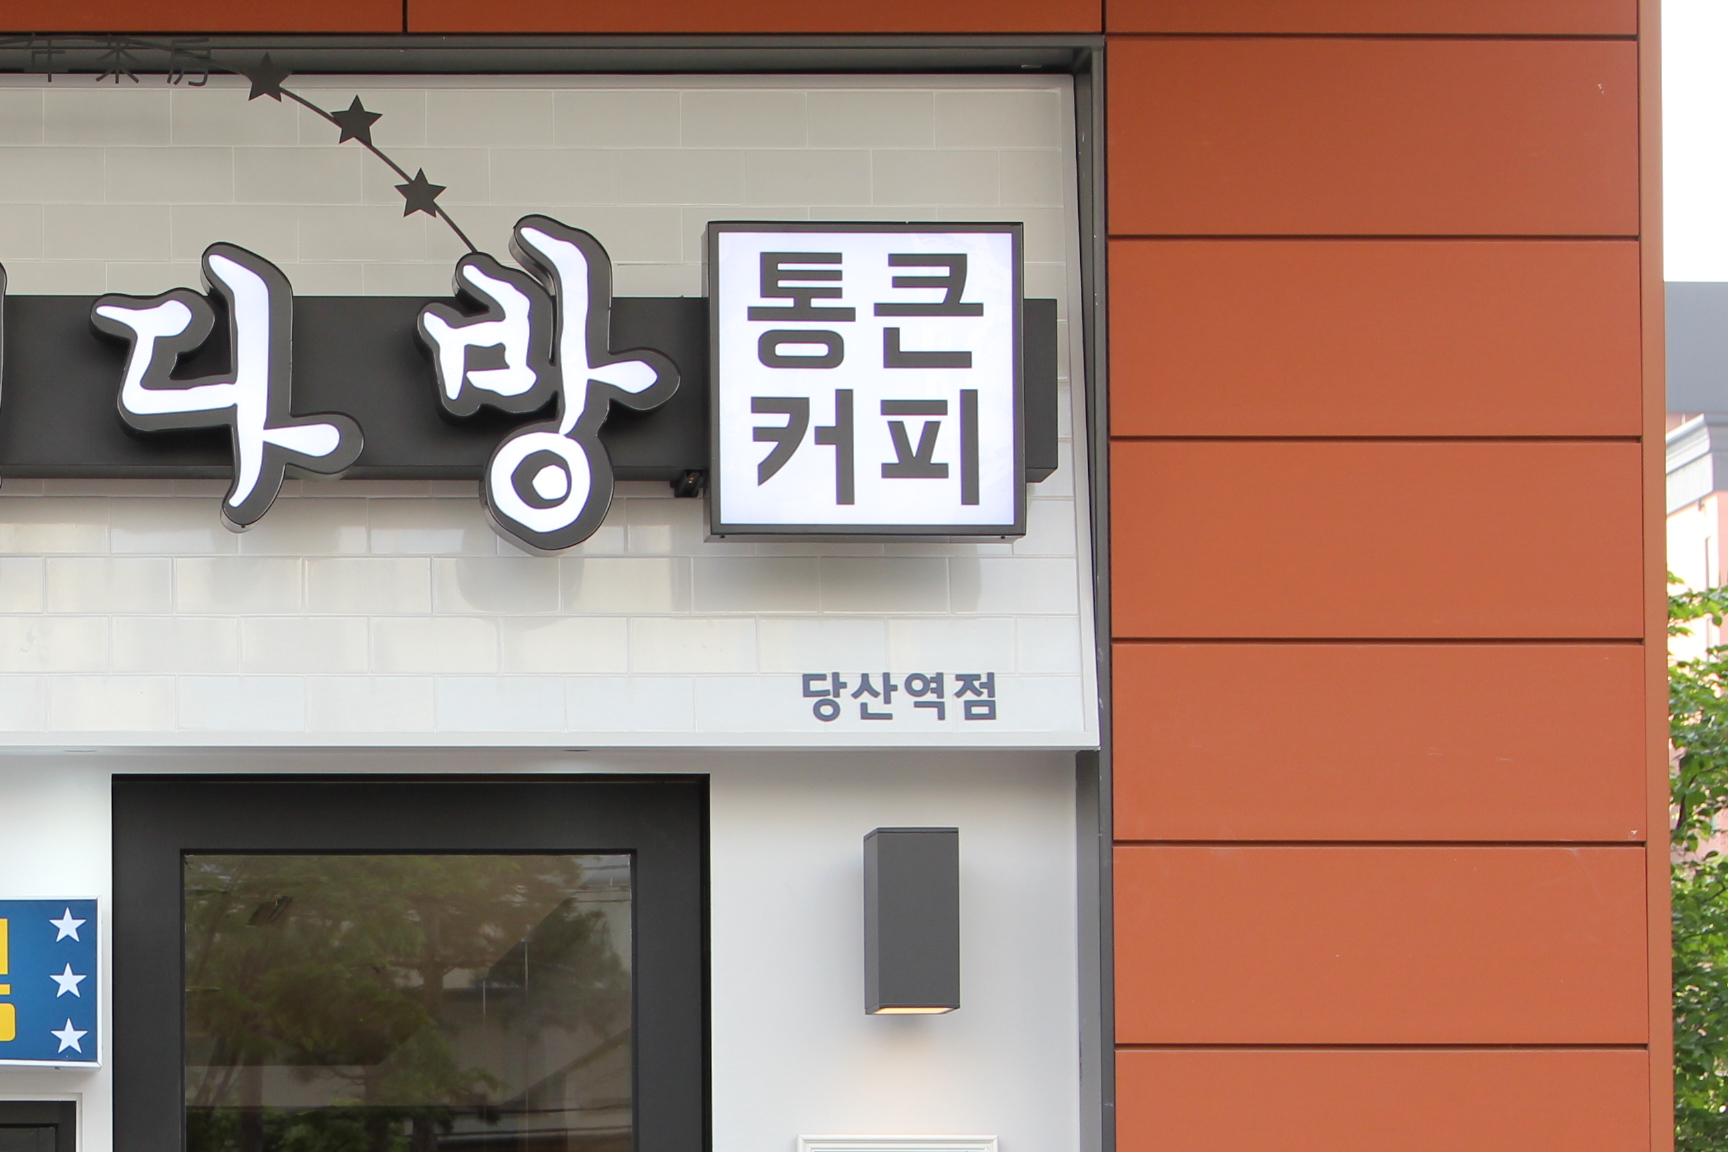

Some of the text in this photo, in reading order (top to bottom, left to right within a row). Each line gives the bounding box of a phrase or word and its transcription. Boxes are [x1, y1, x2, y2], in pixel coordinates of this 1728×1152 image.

[746, 251, 984, 370] 통큰
[749, 388, 981, 506] 커피
[801, 671, 997, 722] 당산역점
